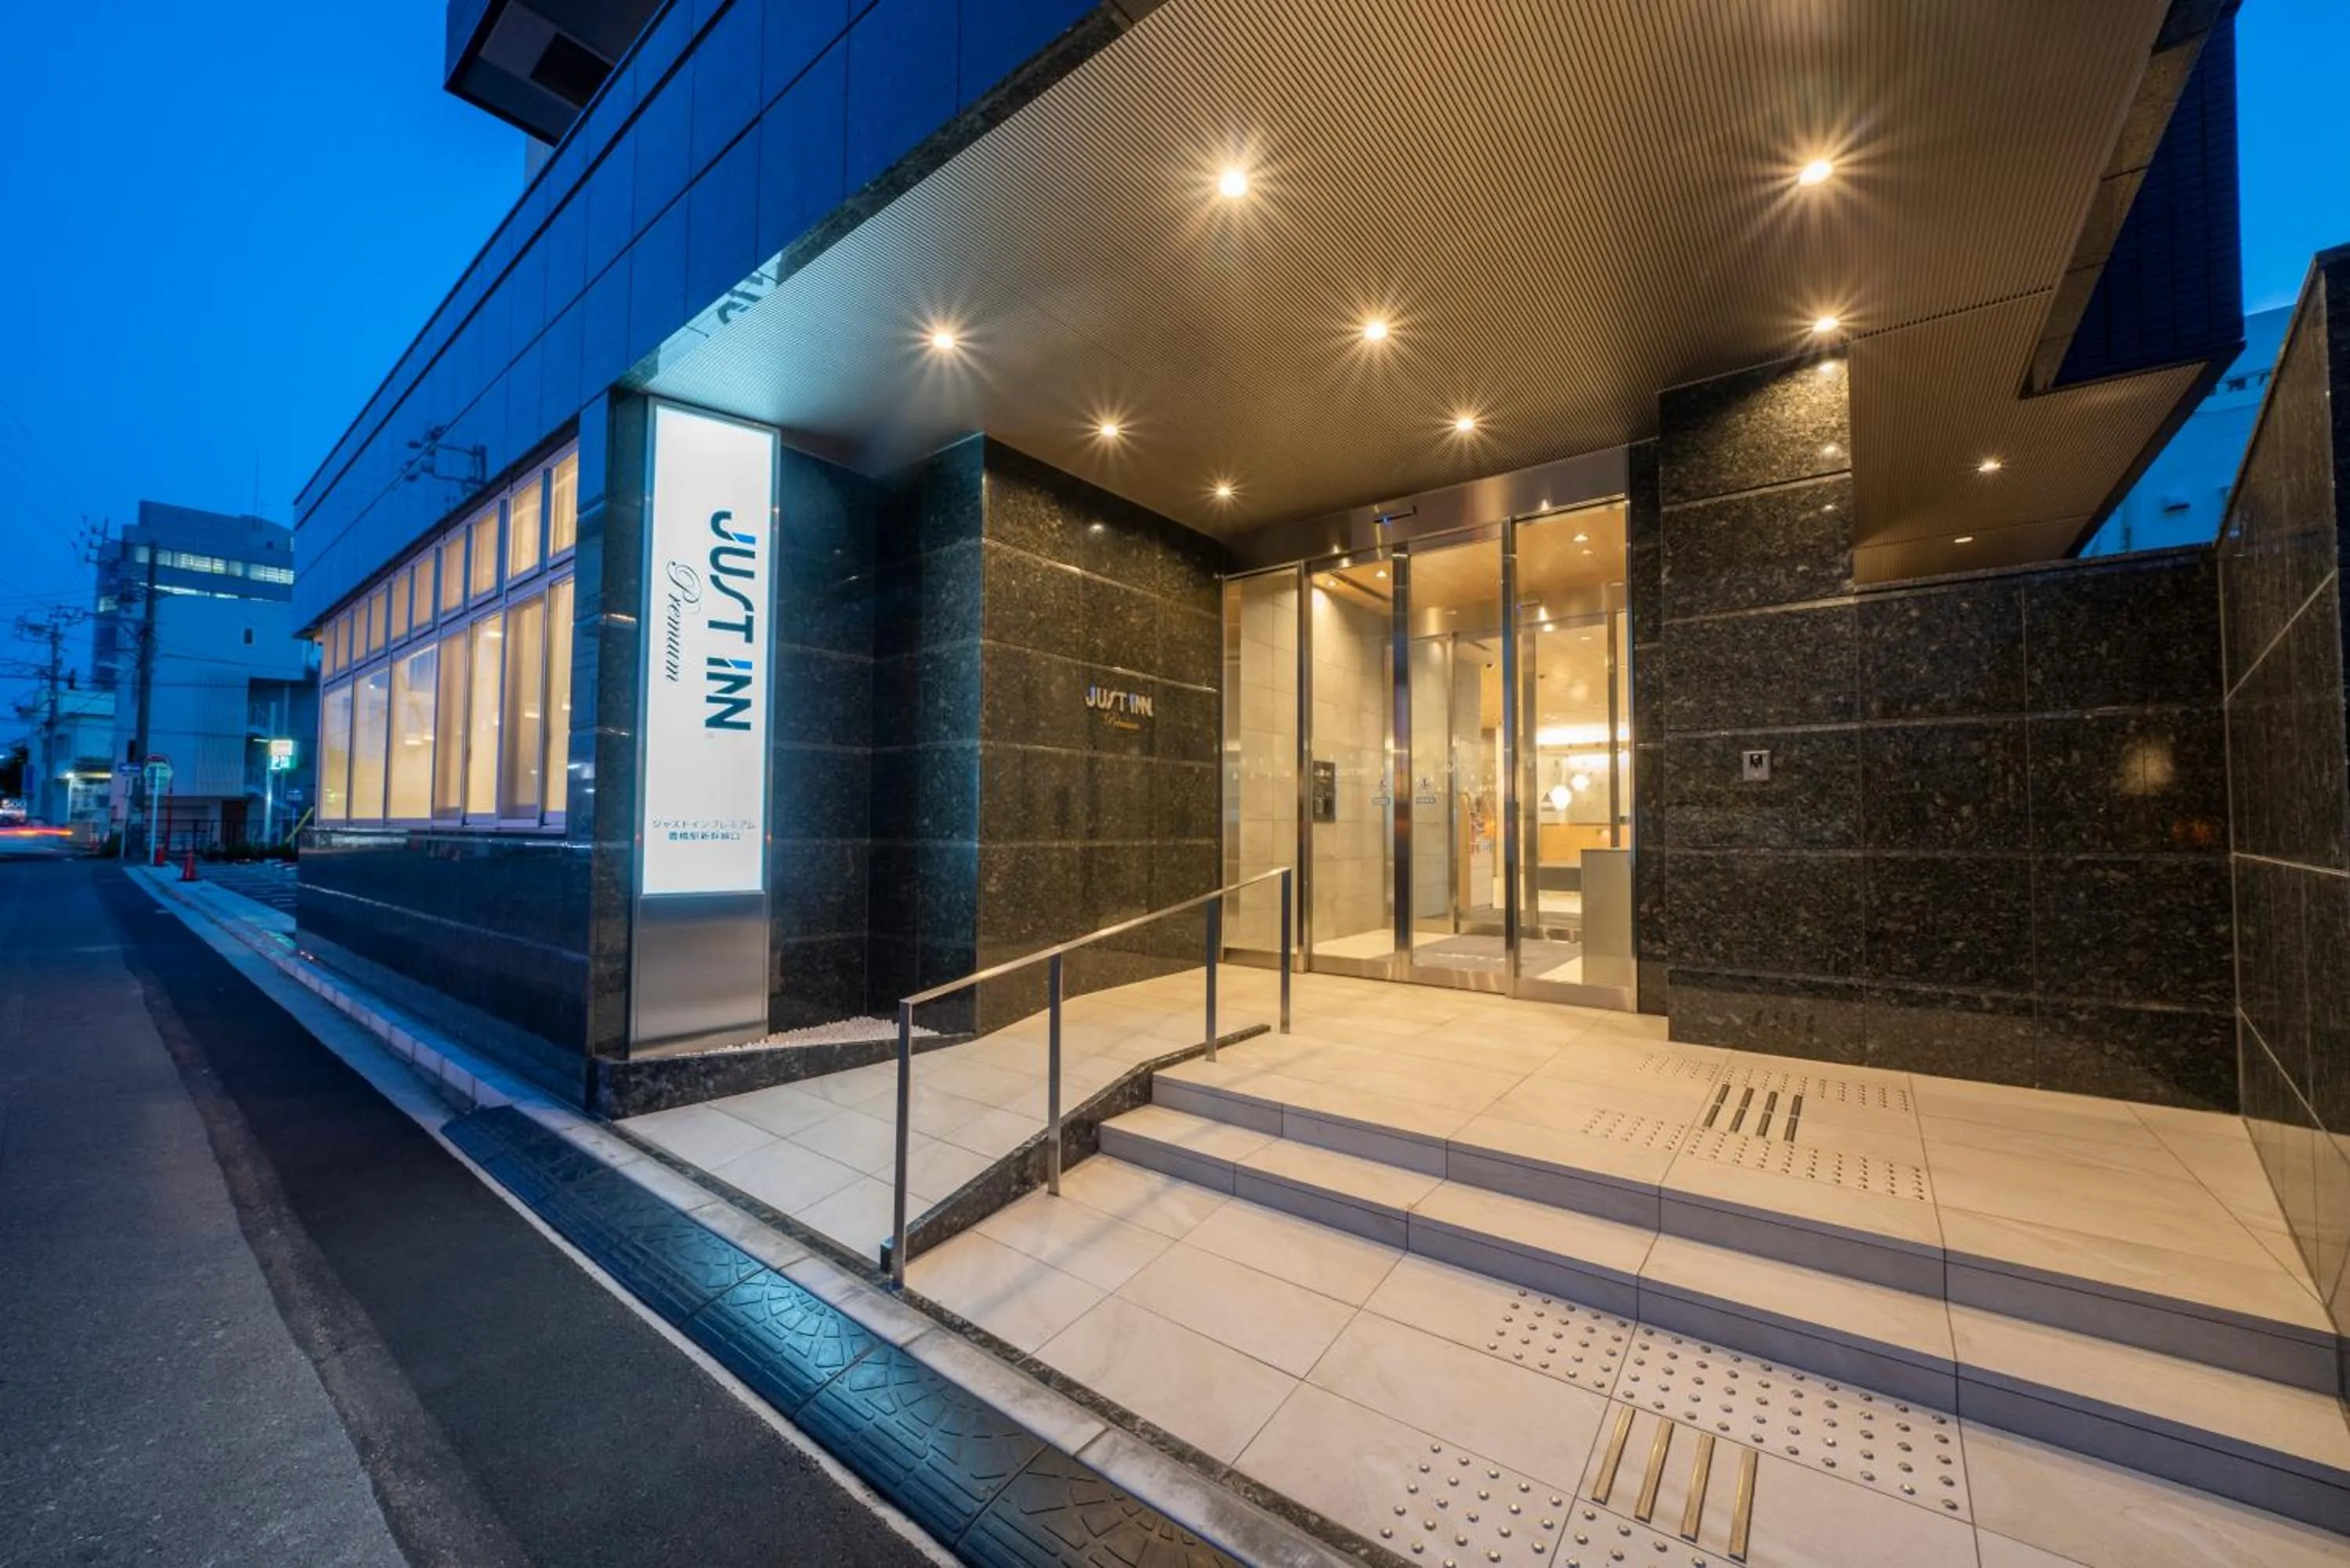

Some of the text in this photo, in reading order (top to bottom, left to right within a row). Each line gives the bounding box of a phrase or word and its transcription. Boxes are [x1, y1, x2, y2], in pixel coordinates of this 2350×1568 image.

[666, 559, 702, 681] Premium
[705, 511, 755, 731] JUST INN
[1084, 685, 1127, 712] JUST
